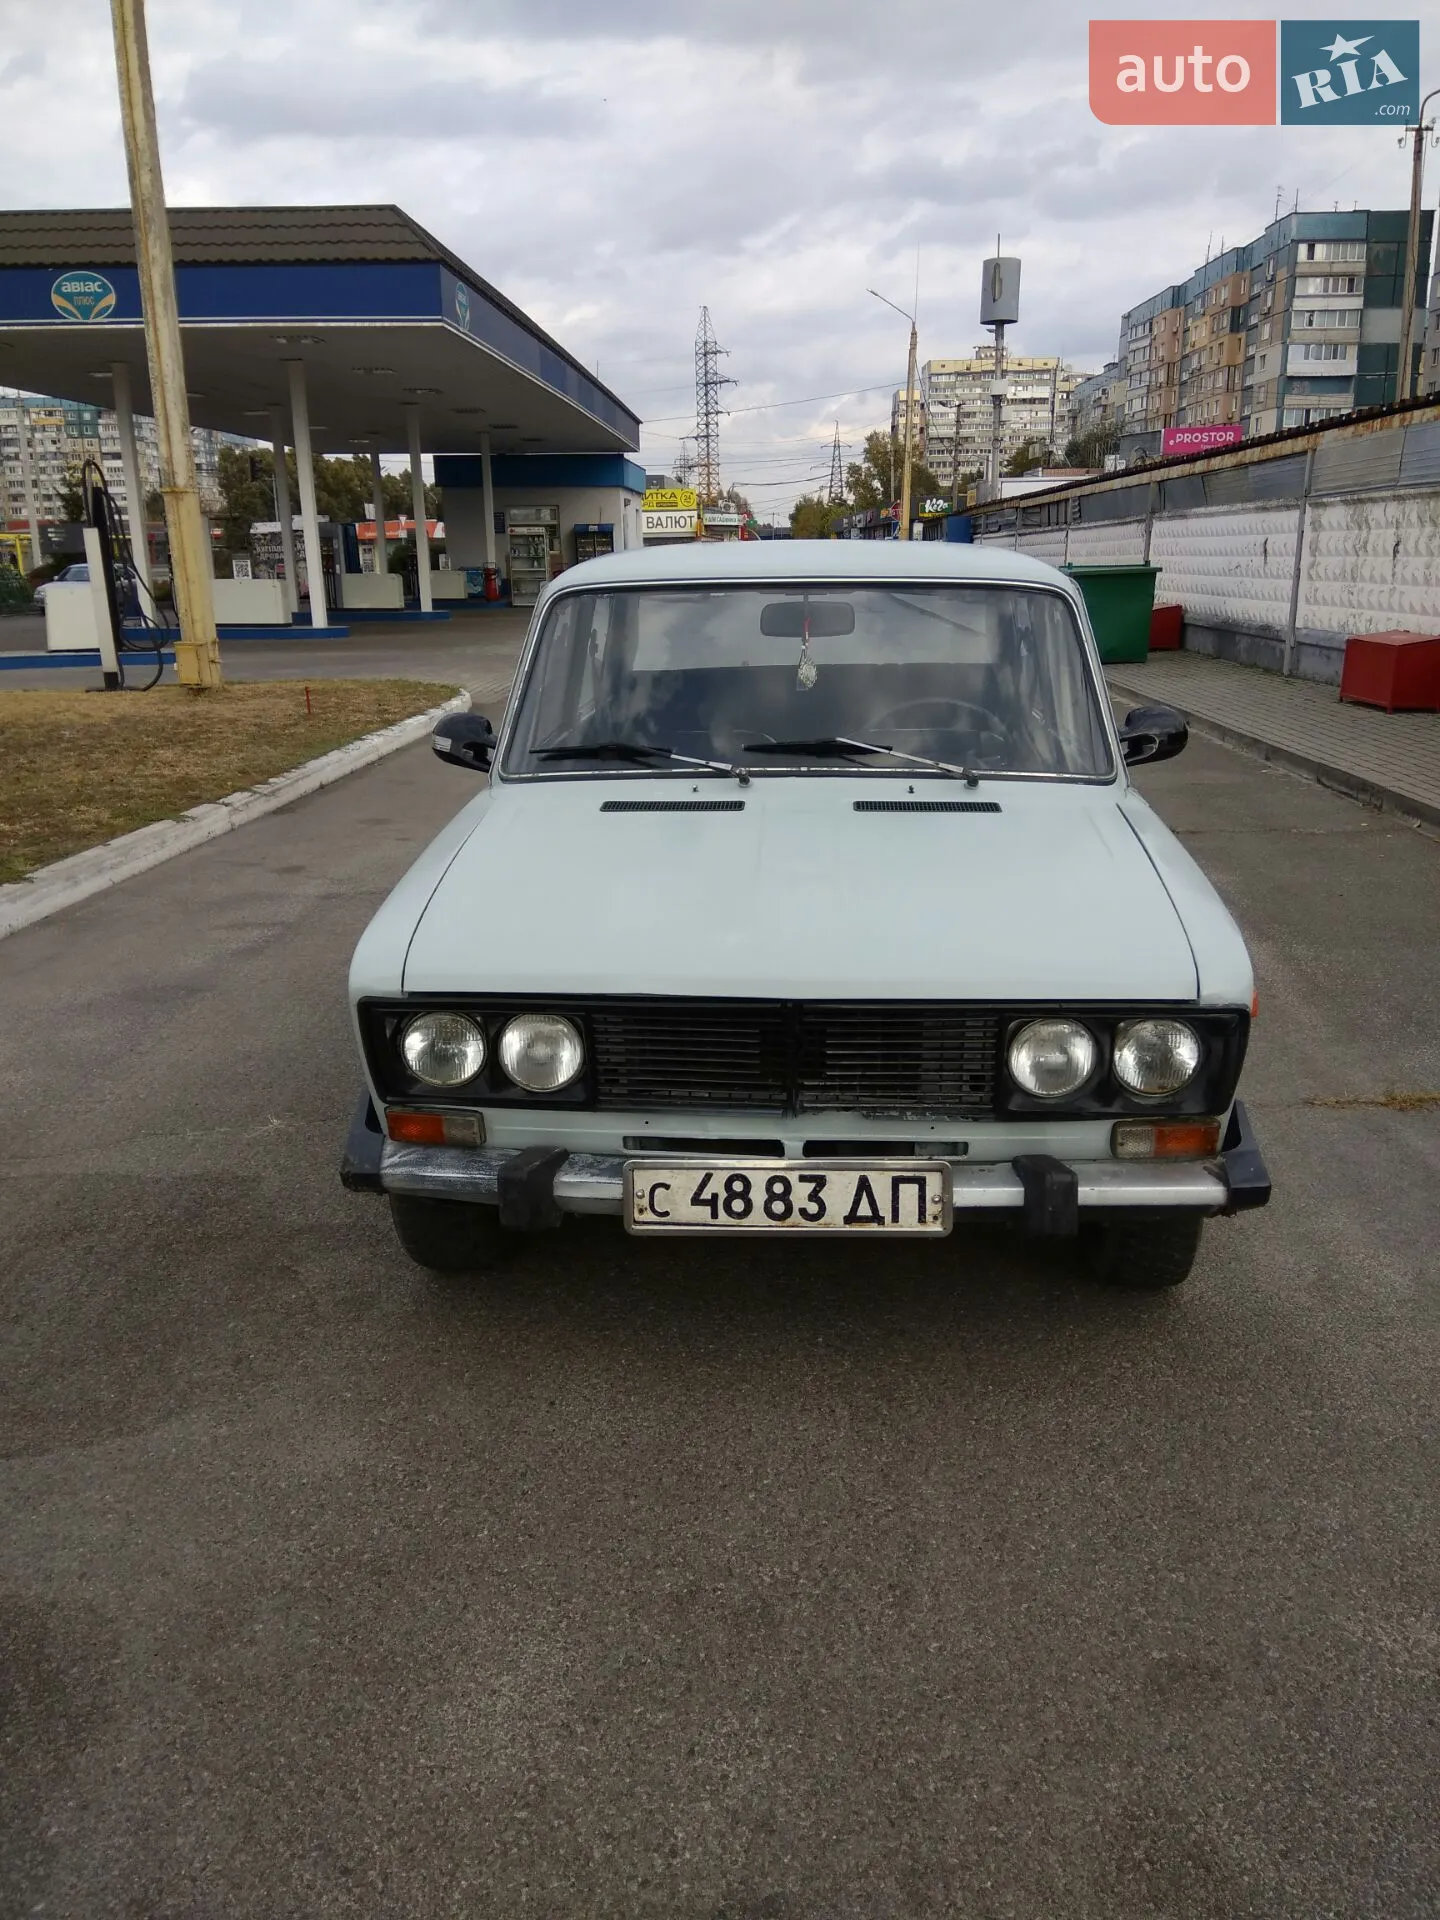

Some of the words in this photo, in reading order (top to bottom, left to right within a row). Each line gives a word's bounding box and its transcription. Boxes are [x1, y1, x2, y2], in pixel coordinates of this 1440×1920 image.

[1176, 432, 1235, 443] PROSTOR
[646, 515, 695, 529] ВАЛЮТ
[843, 1174, 927, 1225] ДП
